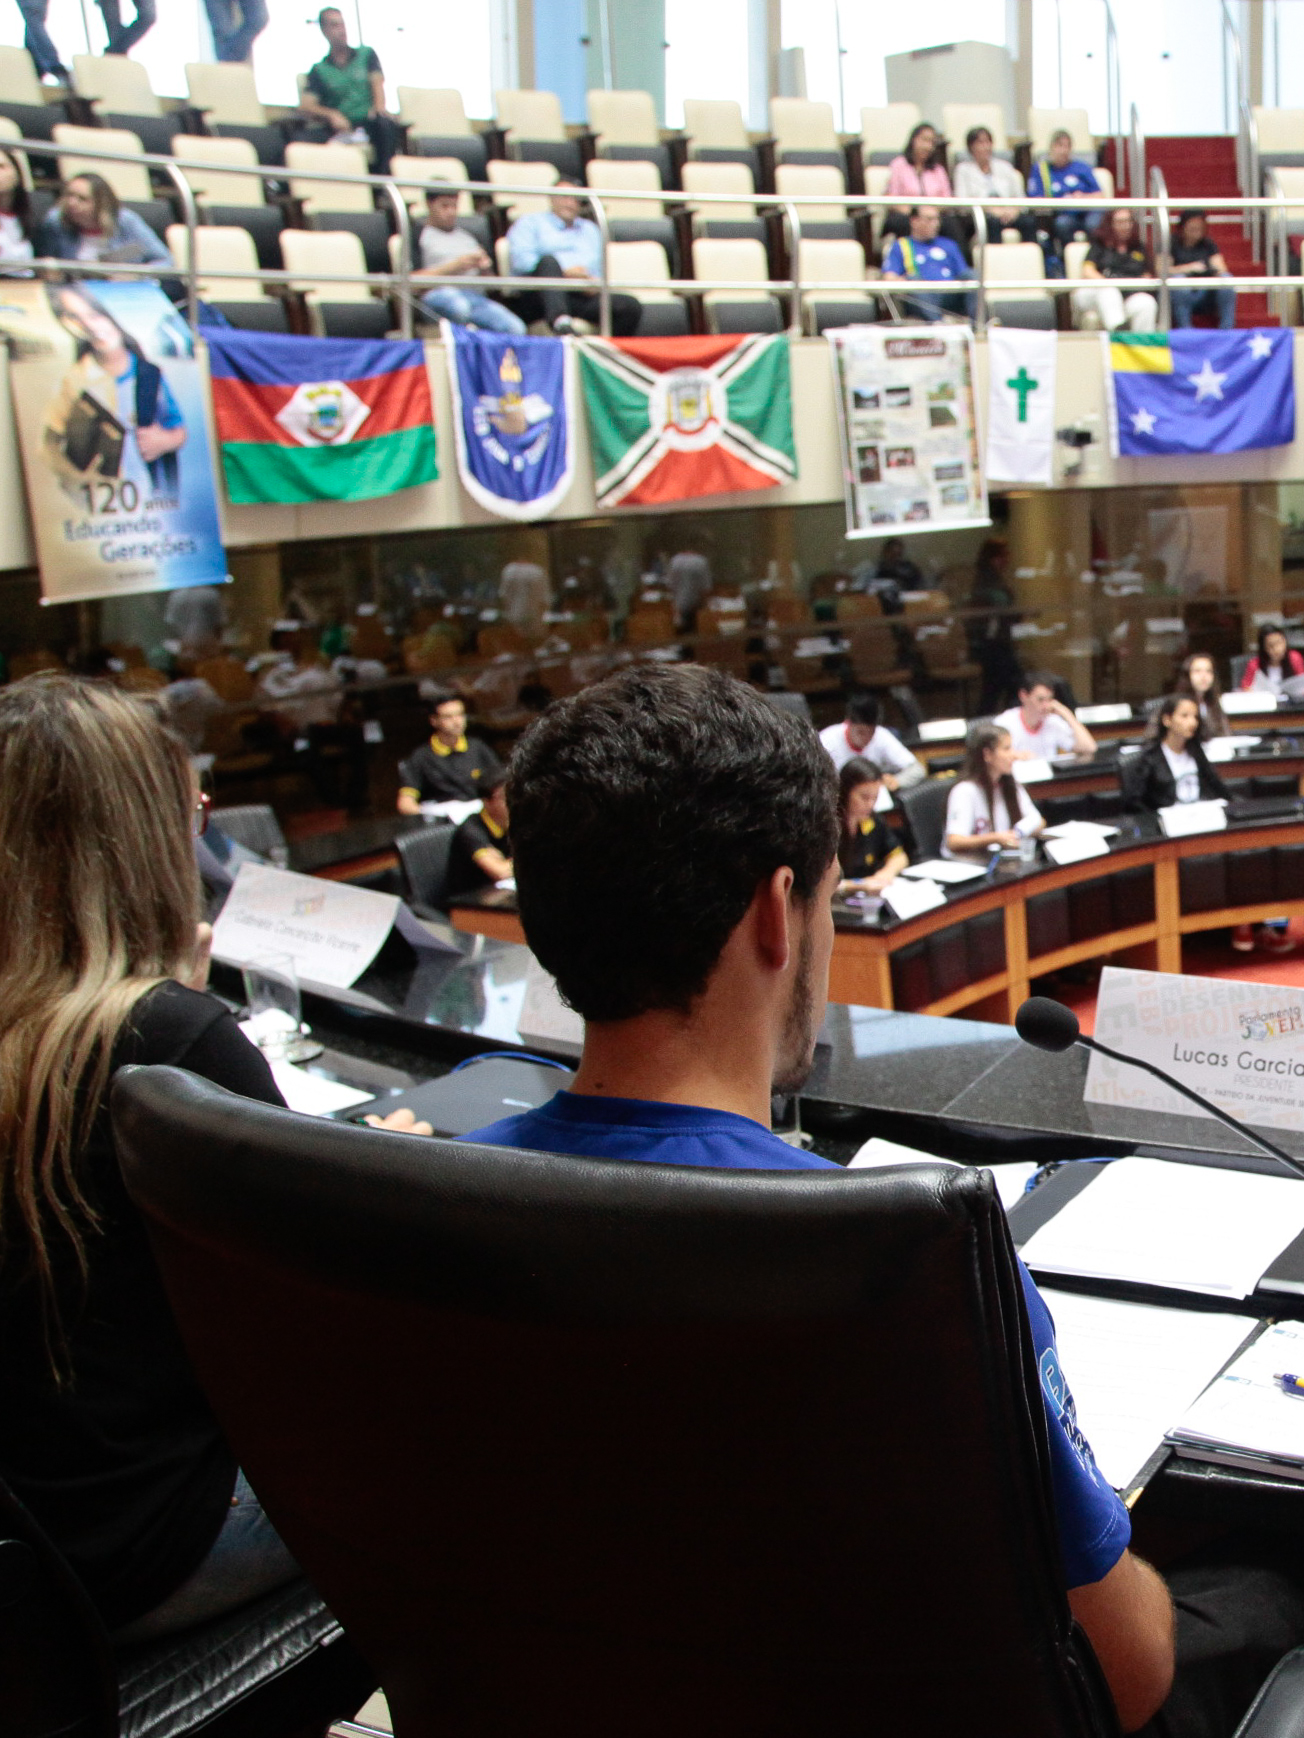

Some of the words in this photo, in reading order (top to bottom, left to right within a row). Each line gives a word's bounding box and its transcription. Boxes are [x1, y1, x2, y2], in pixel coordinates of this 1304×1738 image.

[79, 480, 139, 514] 120
[63, 517, 162, 541] Educando
[100, 536, 198, 564] Gerações
[1239, 1006, 1301, 1026] Parlamento
[1173, 1043, 1229, 1067] Lucas
[1233, 1073, 1296, 1094] PRESIDENTE
